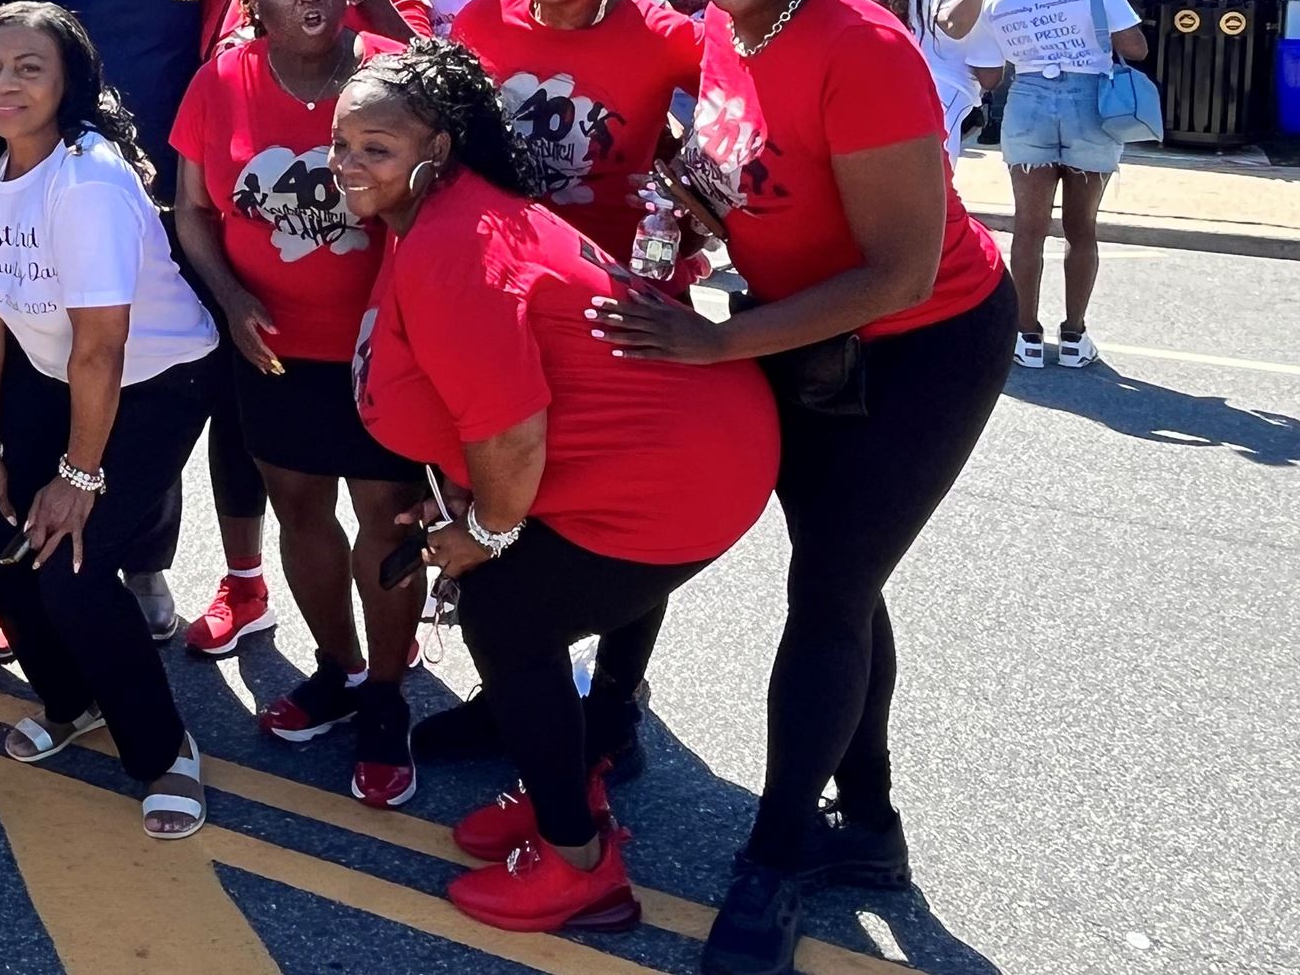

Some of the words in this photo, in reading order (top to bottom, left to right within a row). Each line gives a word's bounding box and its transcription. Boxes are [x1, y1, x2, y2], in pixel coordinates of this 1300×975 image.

[1035, 25, 1081, 42] PRIDE
[272, 160, 341, 211] 40
[24, 301, 57, 315] 2025
